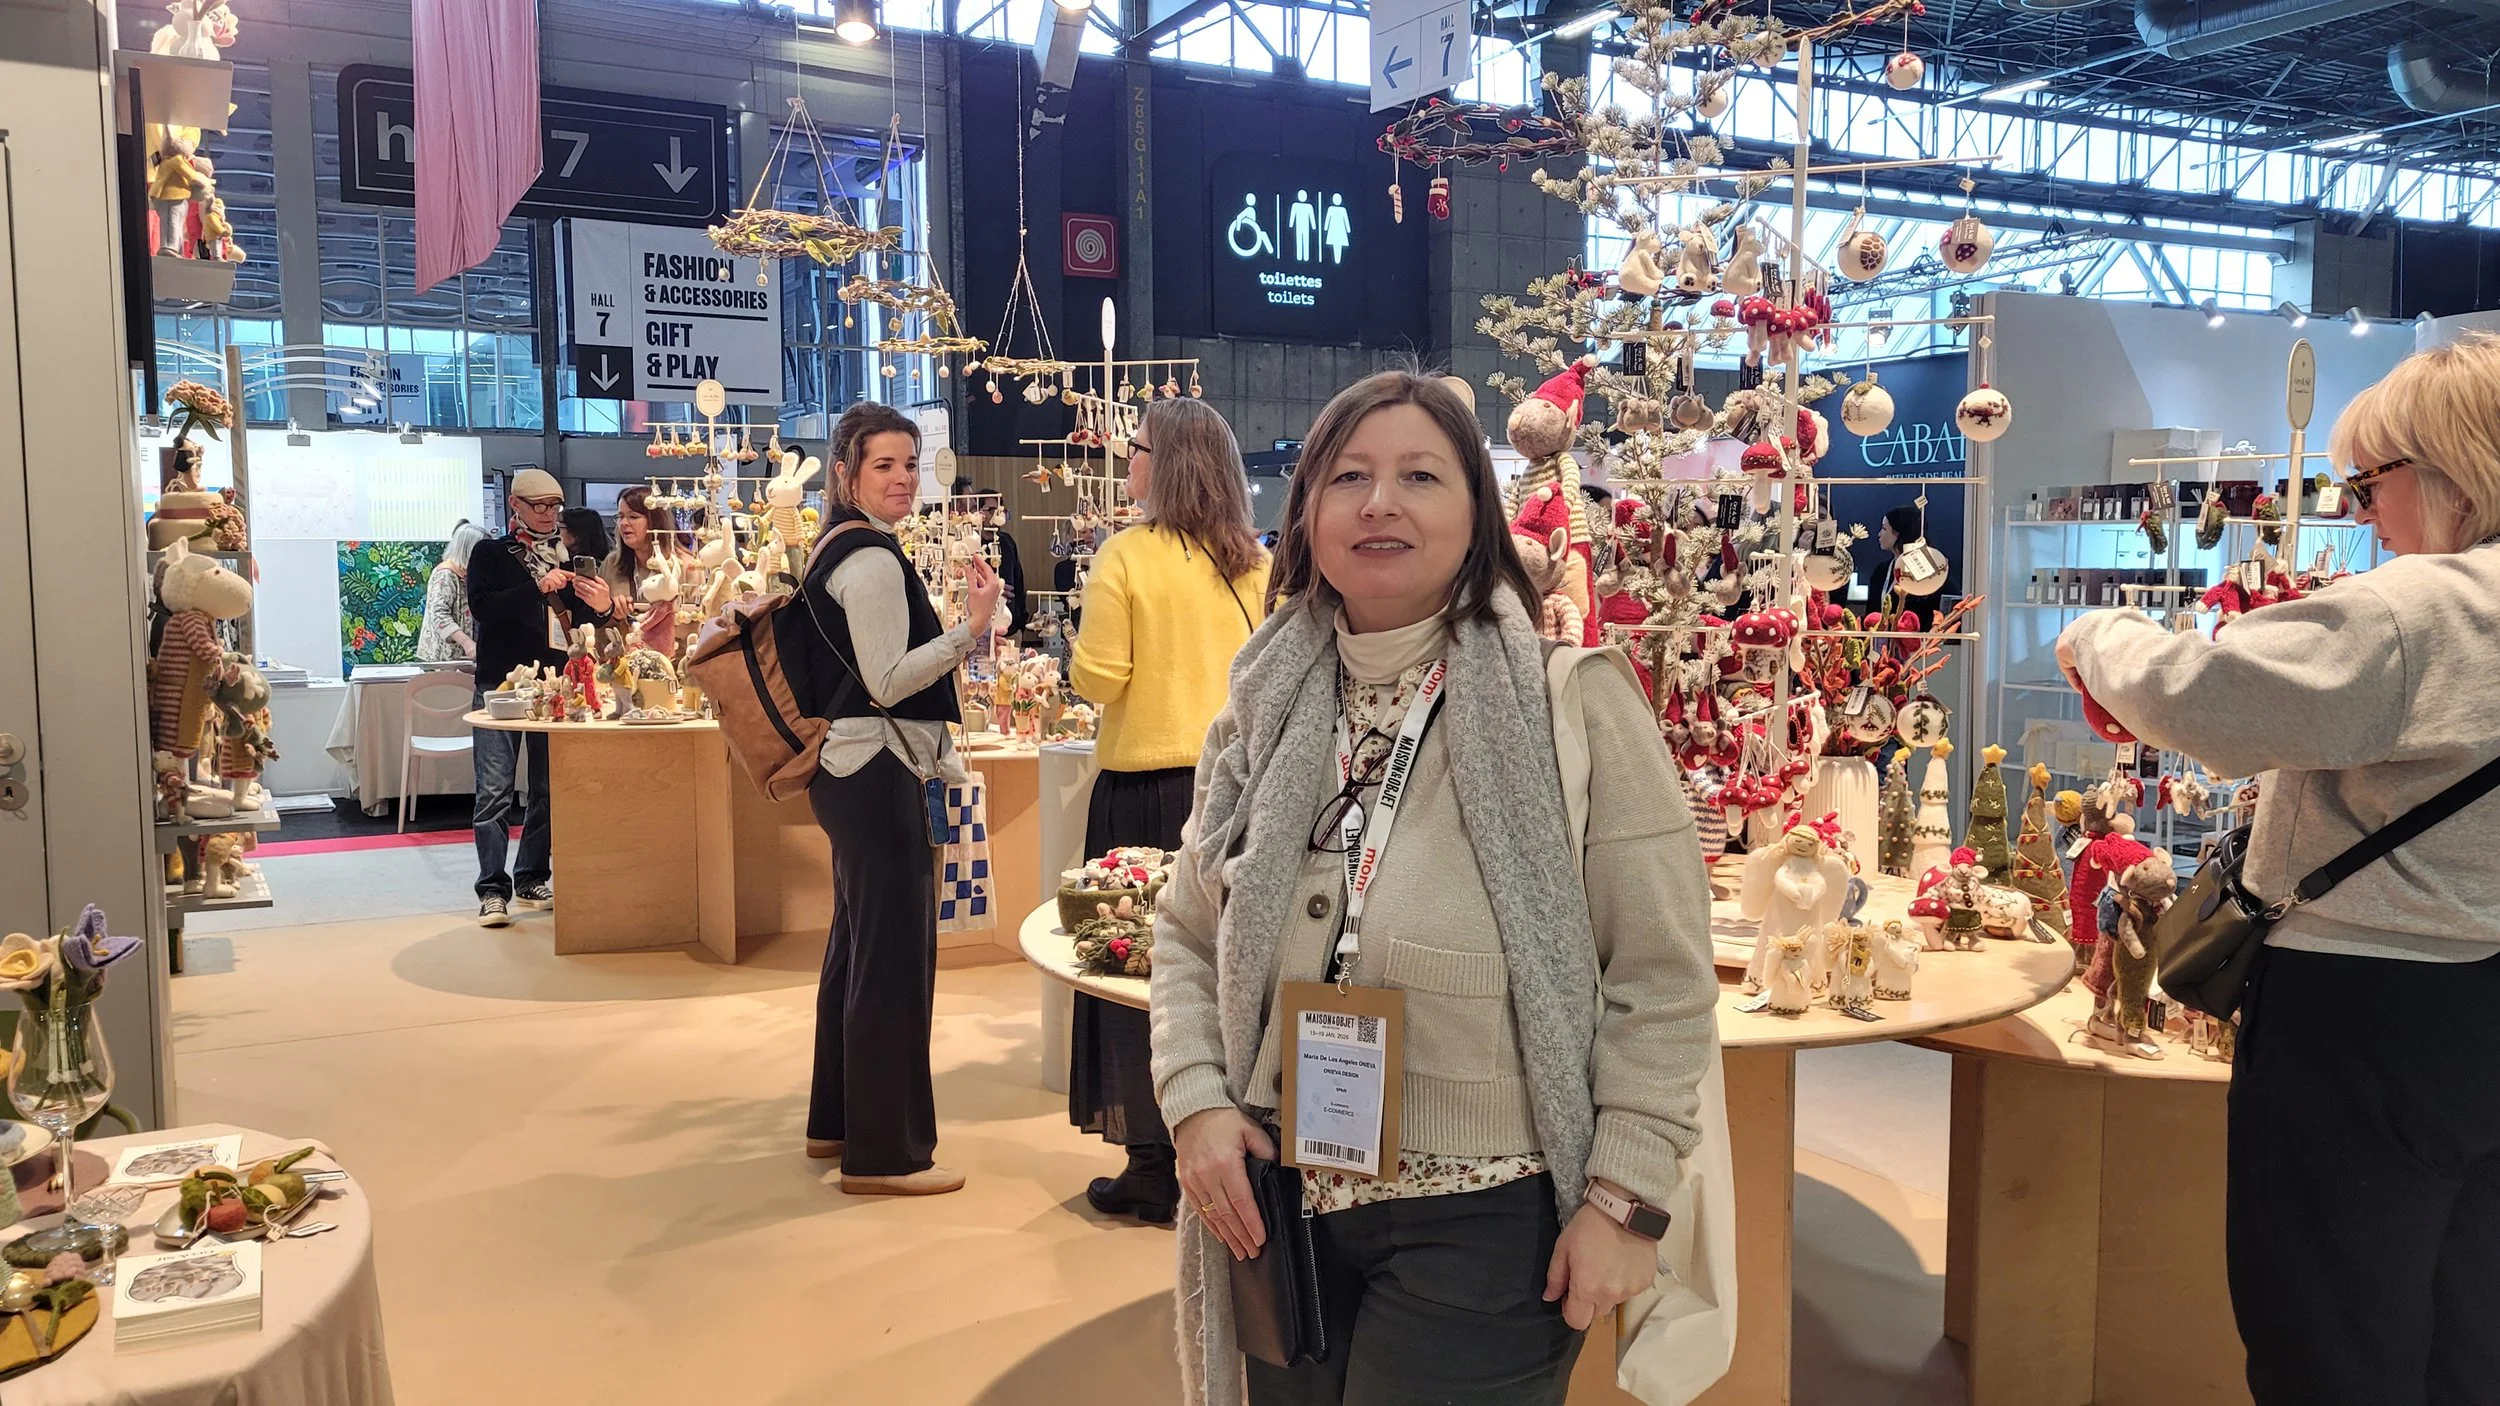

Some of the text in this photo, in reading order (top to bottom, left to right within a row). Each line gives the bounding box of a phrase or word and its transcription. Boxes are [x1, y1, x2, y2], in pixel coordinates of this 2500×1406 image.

[1440, 32, 1454, 77] 7
[551, 129, 590, 178] 7
[644, 252, 734, 283] FASHION
[1259, 271, 1322, 288] toilettes
[591, 292, 615, 308] HALL
[644, 284, 768, 310] & ACCESSORIES
[1267, 290, 1315, 305] toilets
[596, 312, 610, 337] 7
[646, 321, 693, 348] GIFT
[647, 353, 719, 380] & PLAY
[1380, 735, 1415, 810] MAISON&OBJET
[1356, 848, 1376, 892] mom
[1305, 1012, 1355, 1029] MAISON&OBJET
[1338, 1057, 1358, 1066] Angeles
[1342, 1070, 1359, 1078] DESIGN
[1324, 1107, 1355, 1117] E-COMMERCE
